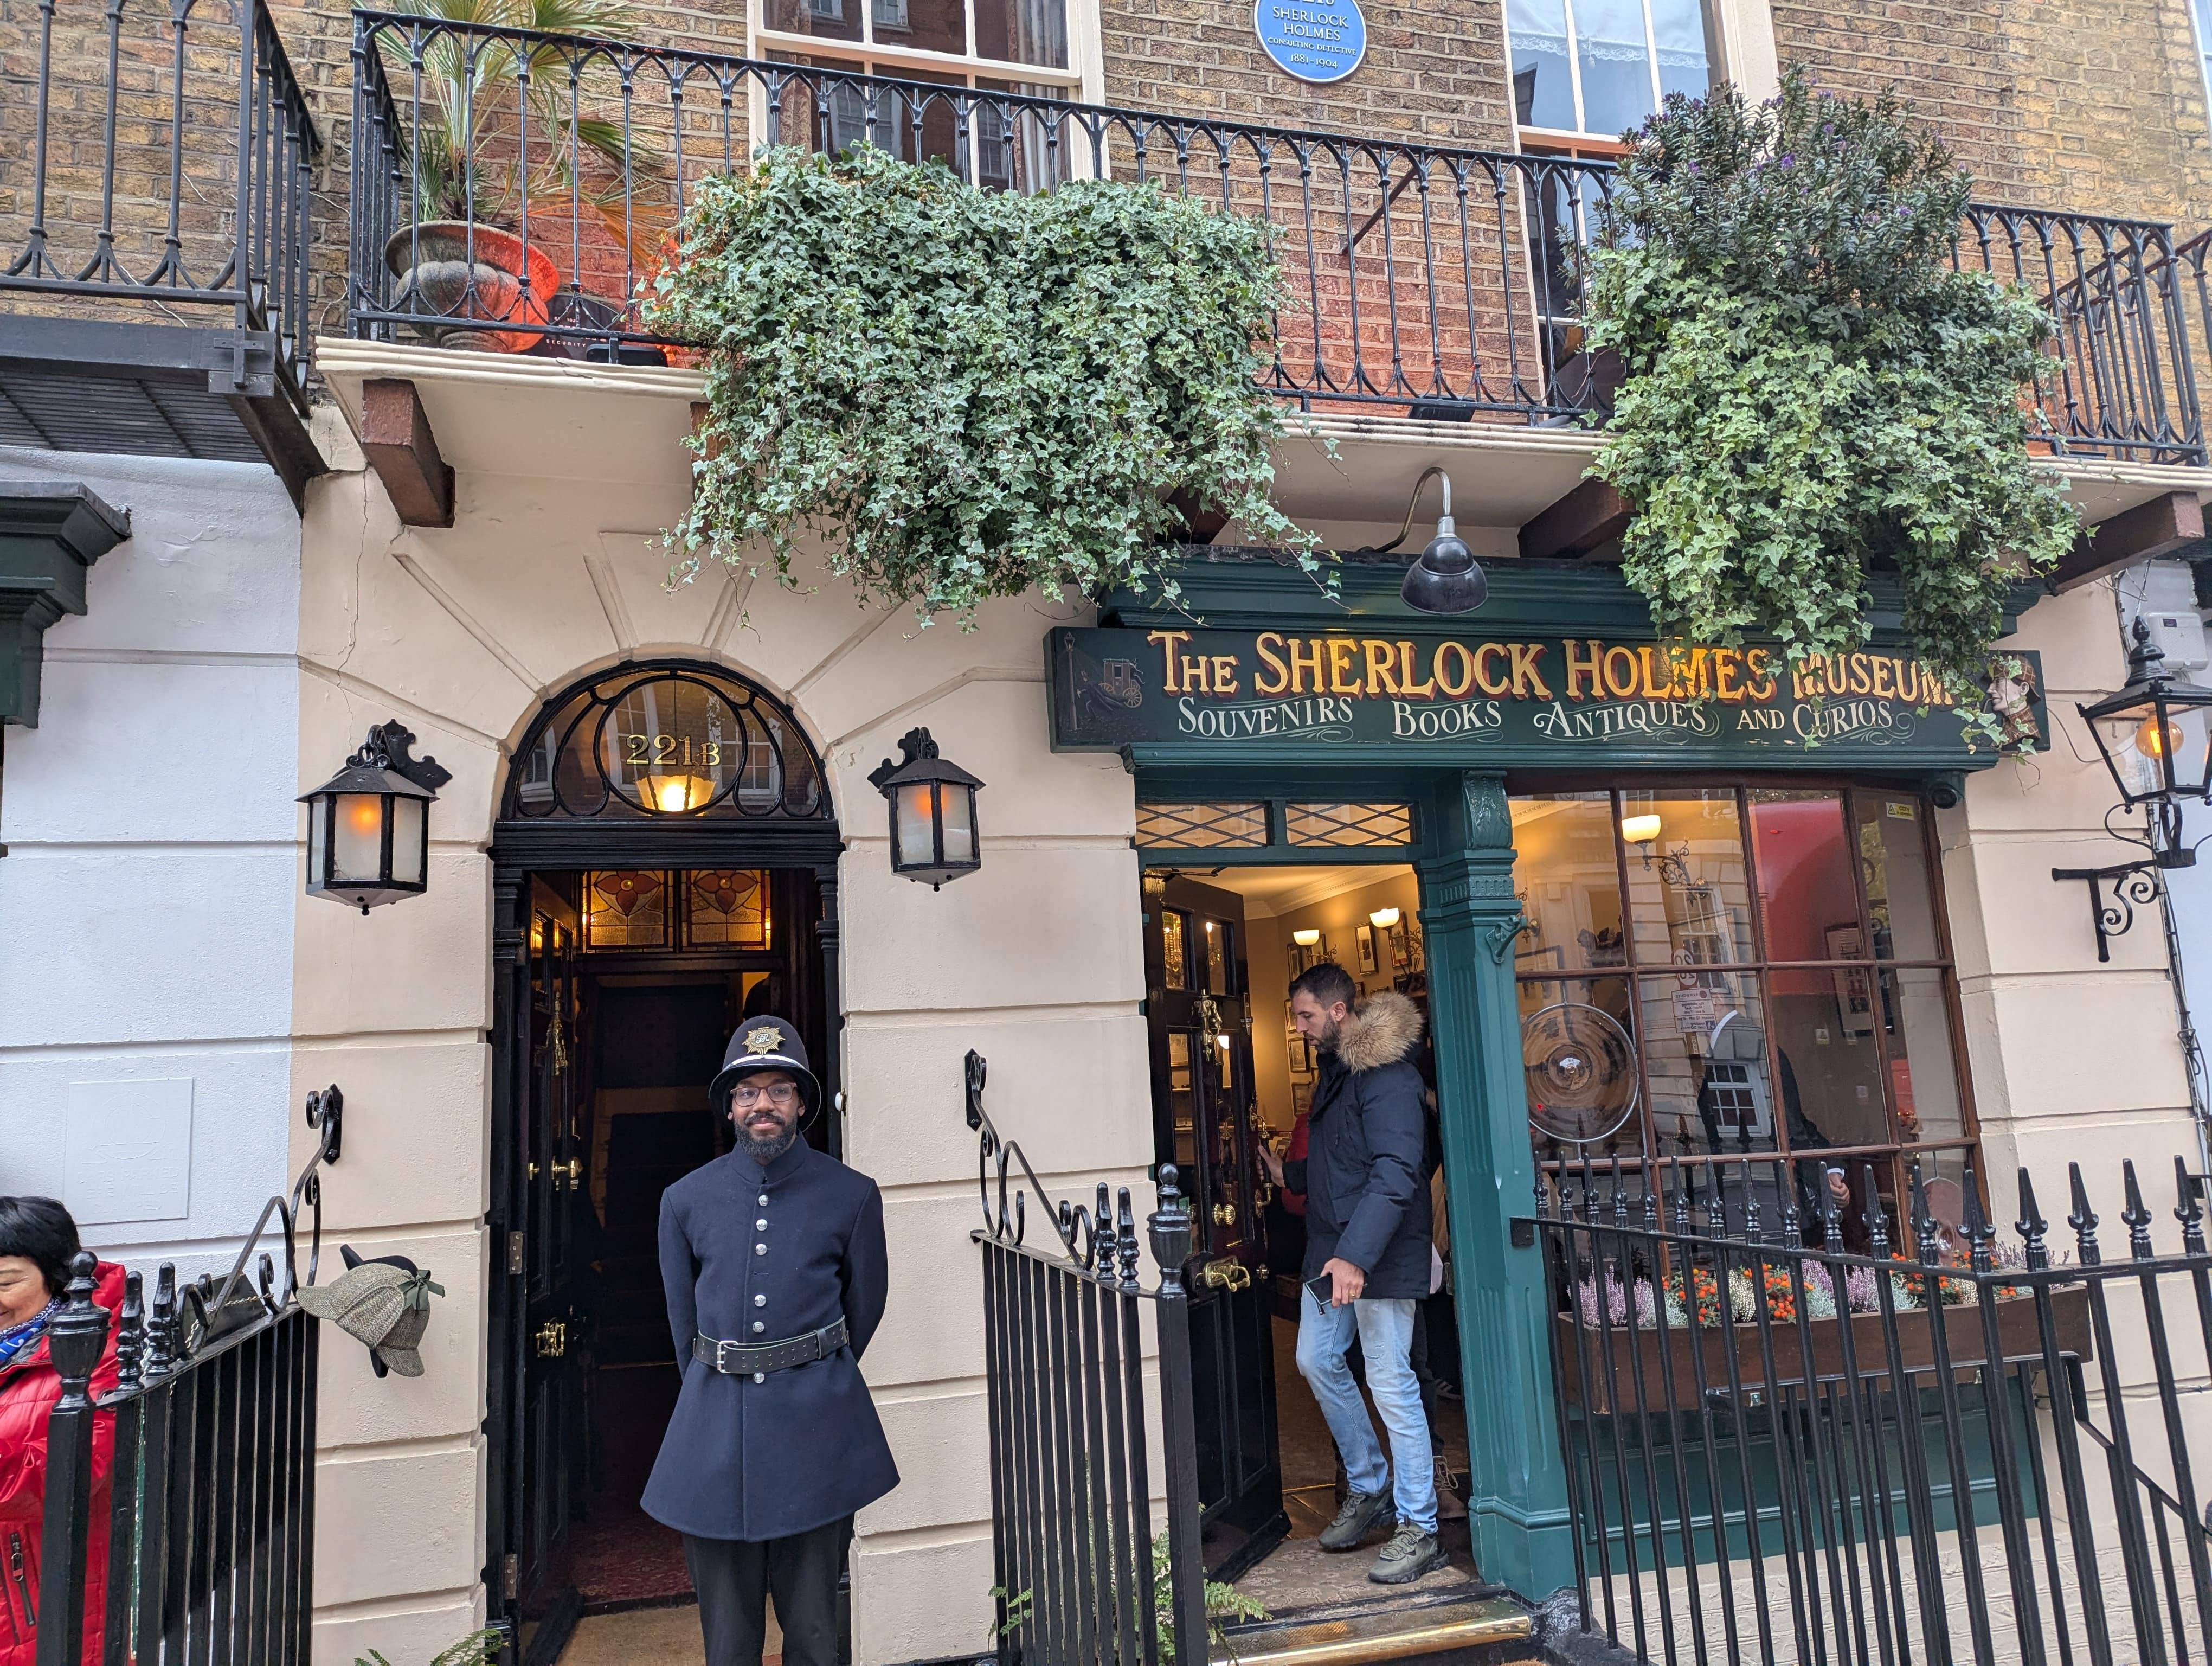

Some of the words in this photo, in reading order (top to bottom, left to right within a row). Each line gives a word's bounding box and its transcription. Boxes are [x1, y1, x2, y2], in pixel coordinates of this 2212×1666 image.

[1273, 6, 1348, 28] SHERLOCK
[1284, 22, 1340, 41] HOLMES
[1268, 37, 1314, 50] CONSULTING
[1317, 44, 1356, 55] DETECTIVE
[546, 339, 586, 348] SECURITY
[1147, 629, 1240, 695] THE
[1255, 632, 1552, 699] SHERLOCK
[1561, 639, 1774, 702] HOLMES
[1793, 651, 1953, 706] MUSEUM
[1179, 696, 1354, 738] SOUVENIRS
[1391, 701, 1501, 736] BOOKS
[1533, 701, 1706, 737] ANTIQUES
[1736, 709, 1785, 730] AND
[1793, 701, 1892, 738] CURIOS
[626, 734, 721, 766] 221B
